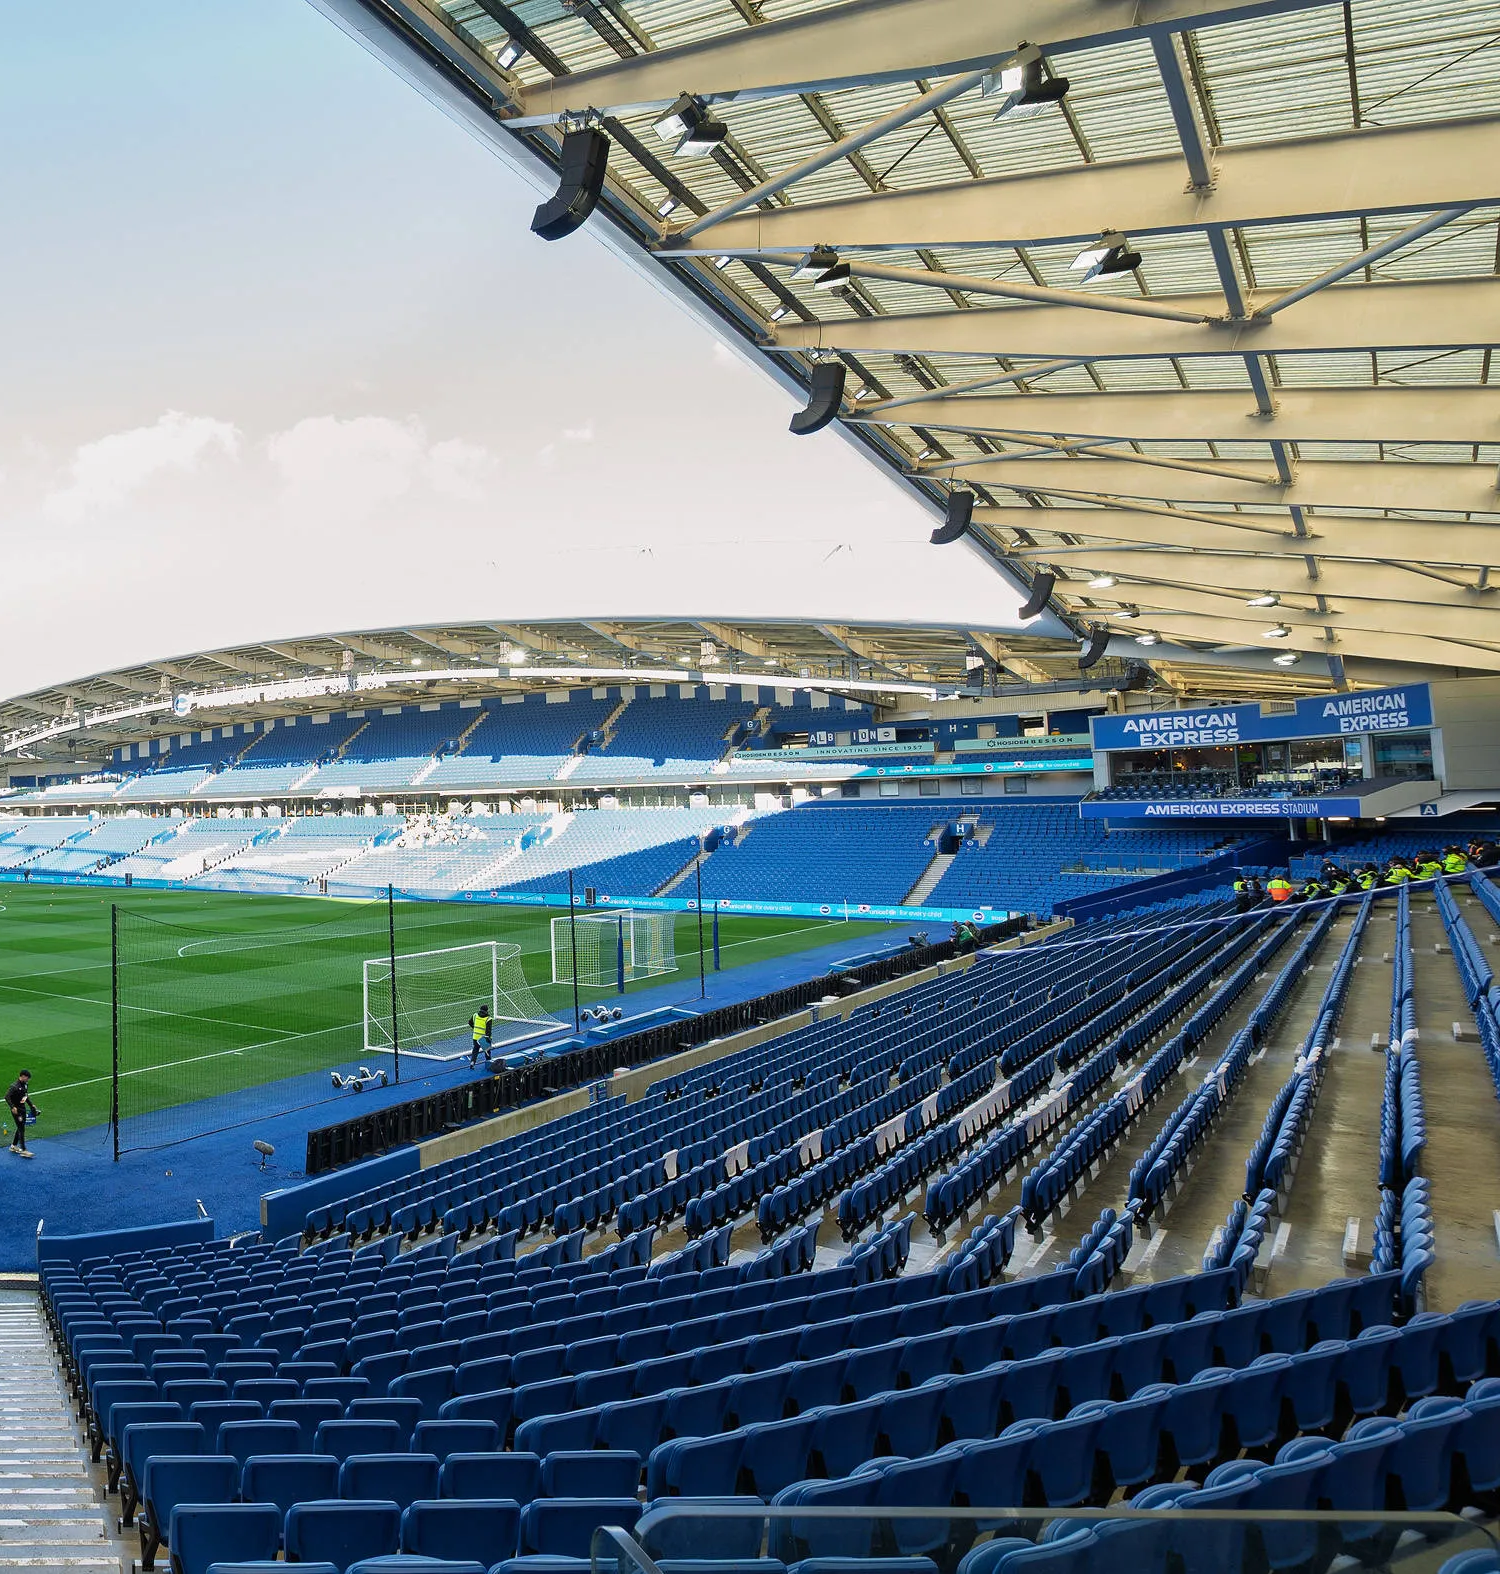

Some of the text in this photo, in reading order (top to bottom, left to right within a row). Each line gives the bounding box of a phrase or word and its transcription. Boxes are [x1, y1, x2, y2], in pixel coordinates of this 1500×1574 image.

[1322, 692, 1406, 718] AMERICAN
[1122, 712, 1237, 733] AMERICAN
[1340, 711, 1409, 733] EXPRESS
[949, 724, 957, 733] H
[1139, 728, 1240, 747] EXPRESS
[1145, 803, 1319, 815] AMERICAN EXPRESS STADIUM
[1423, 805, 1435, 815] A
[723, 826, 730, 834] G
[956, 824, 965, 833] H
